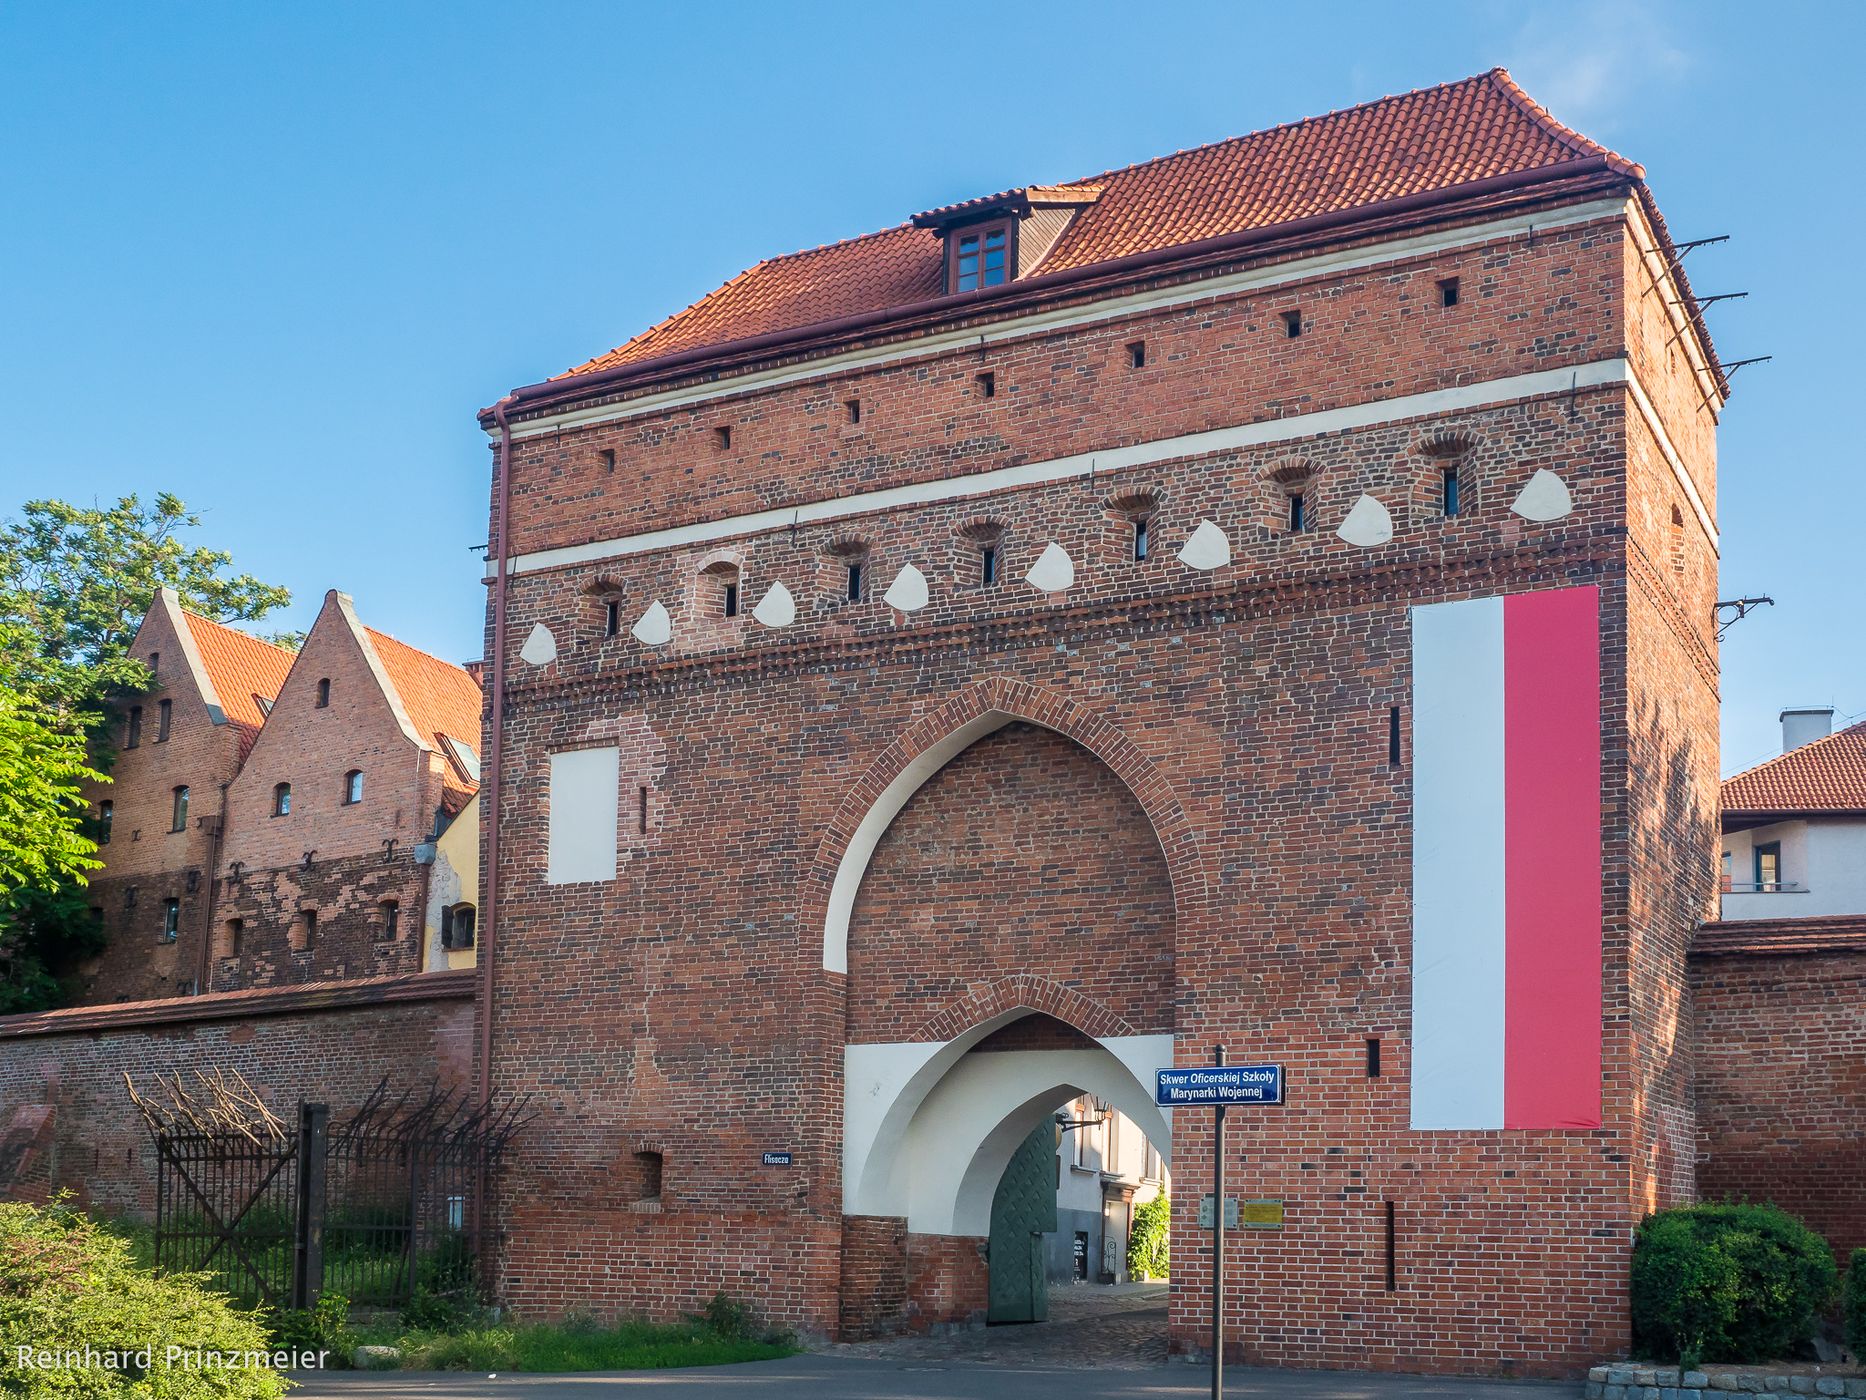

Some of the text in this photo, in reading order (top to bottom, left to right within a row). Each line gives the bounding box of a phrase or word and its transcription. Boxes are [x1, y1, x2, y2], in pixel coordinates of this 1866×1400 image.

[1160, 1071, 1275, 1085] Skwer Oficerskiej Szkoły
[1170, 1086, 1263, 1100] Marynarki Wojennej
